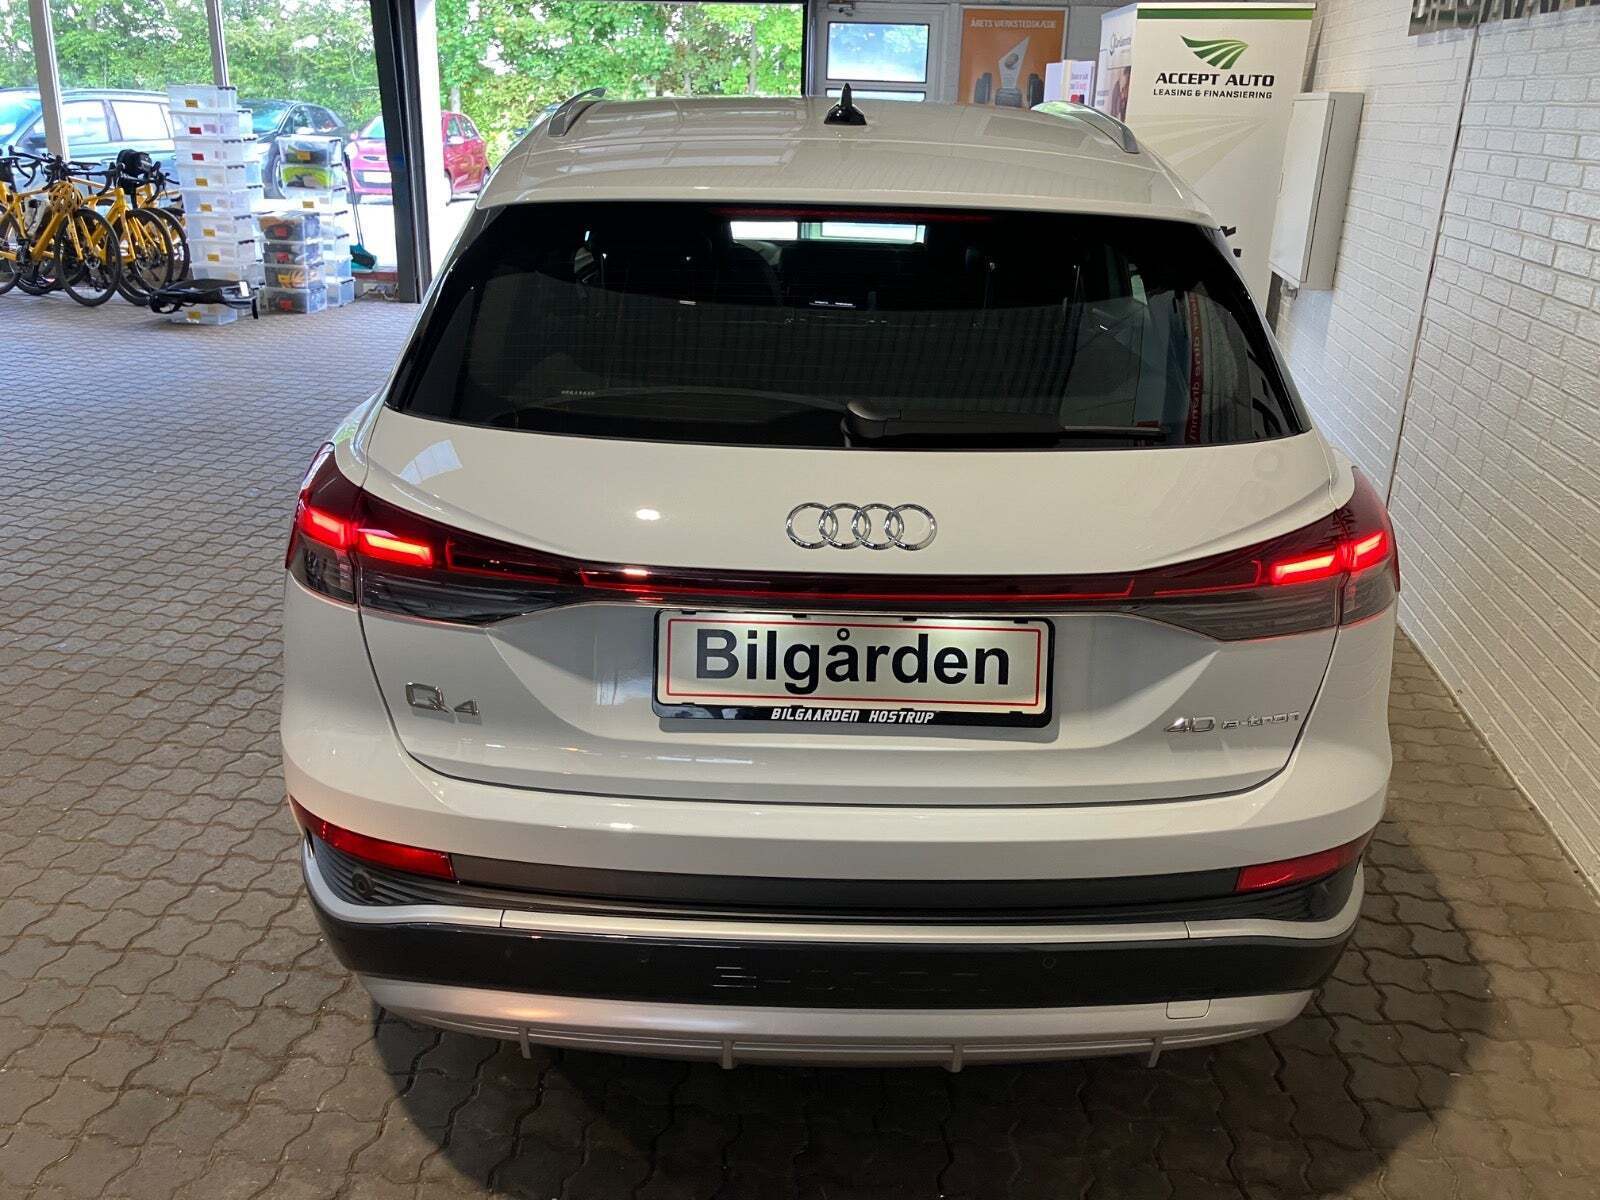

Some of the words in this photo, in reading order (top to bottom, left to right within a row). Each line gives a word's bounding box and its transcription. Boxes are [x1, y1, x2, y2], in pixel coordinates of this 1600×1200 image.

[1155, 72, 1221, 86] ACCEPT
[1225, 74, 1275, 87] AUTO
[1153, 88, 1193, 97] LEASING
[1203, 89, 1273, 99] FINANSIERING
[695, 627, 1009, 695] Bilgården
[405, 682, 480, 715] Q4
[771, 708, 860, 722] BILGAARDEN
[868, 710, 935, 724] HOSTRUP
